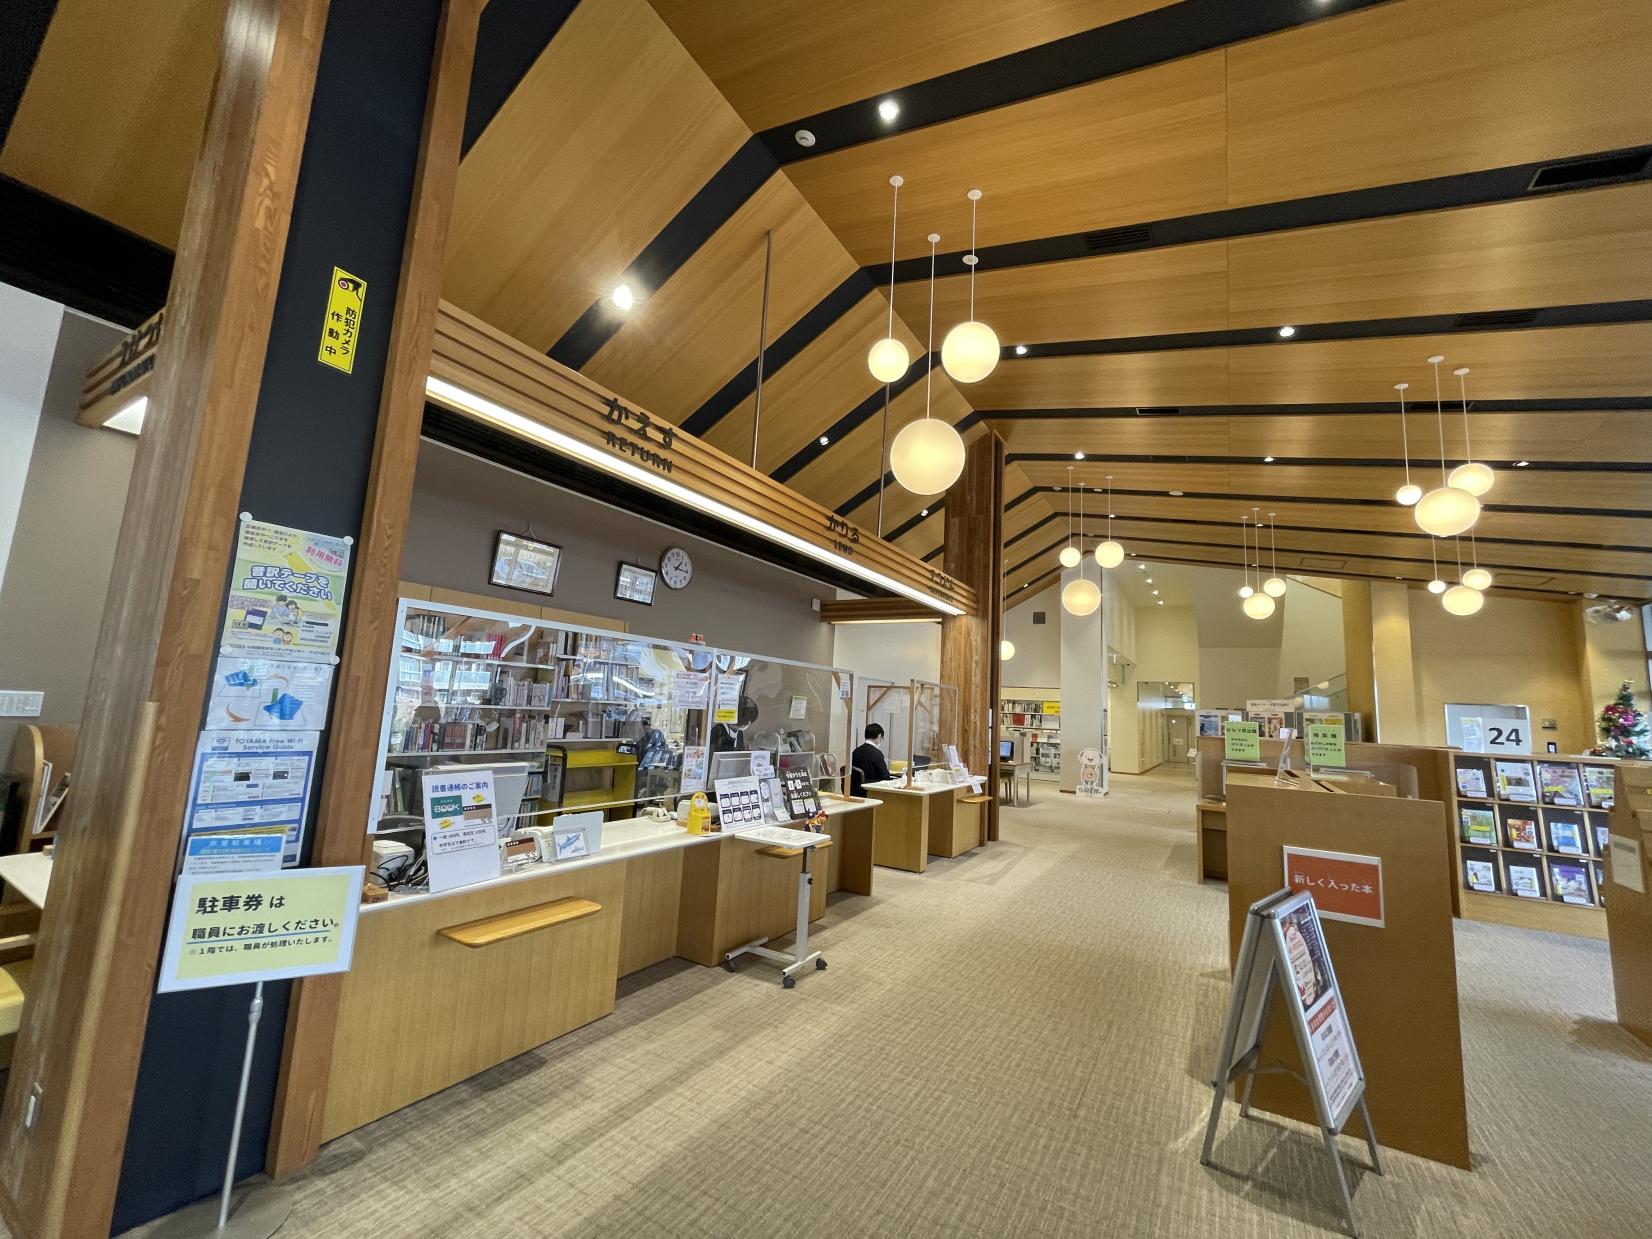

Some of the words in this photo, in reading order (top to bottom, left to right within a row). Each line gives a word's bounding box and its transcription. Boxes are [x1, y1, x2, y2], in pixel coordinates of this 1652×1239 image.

[325, 312, 343, 356] 作動中
[341, 307, 357, 356] 防犯カメラ
[605, 431, 672, 473] RETURN
[826, 515, 859, 544] かりる
[251, 565, 329, 588] 音訳テープを
[242, 577, 333, 601] 聞いてください
[1488, 727, 1523, 746] 24
[1293, 873, 1375, 895] 新しく入った本
[195, 893, 264, 915] 駐車券
[269, 895, 286, 909] は
[191, 918, 340, 940] 職員にお渡しください。
